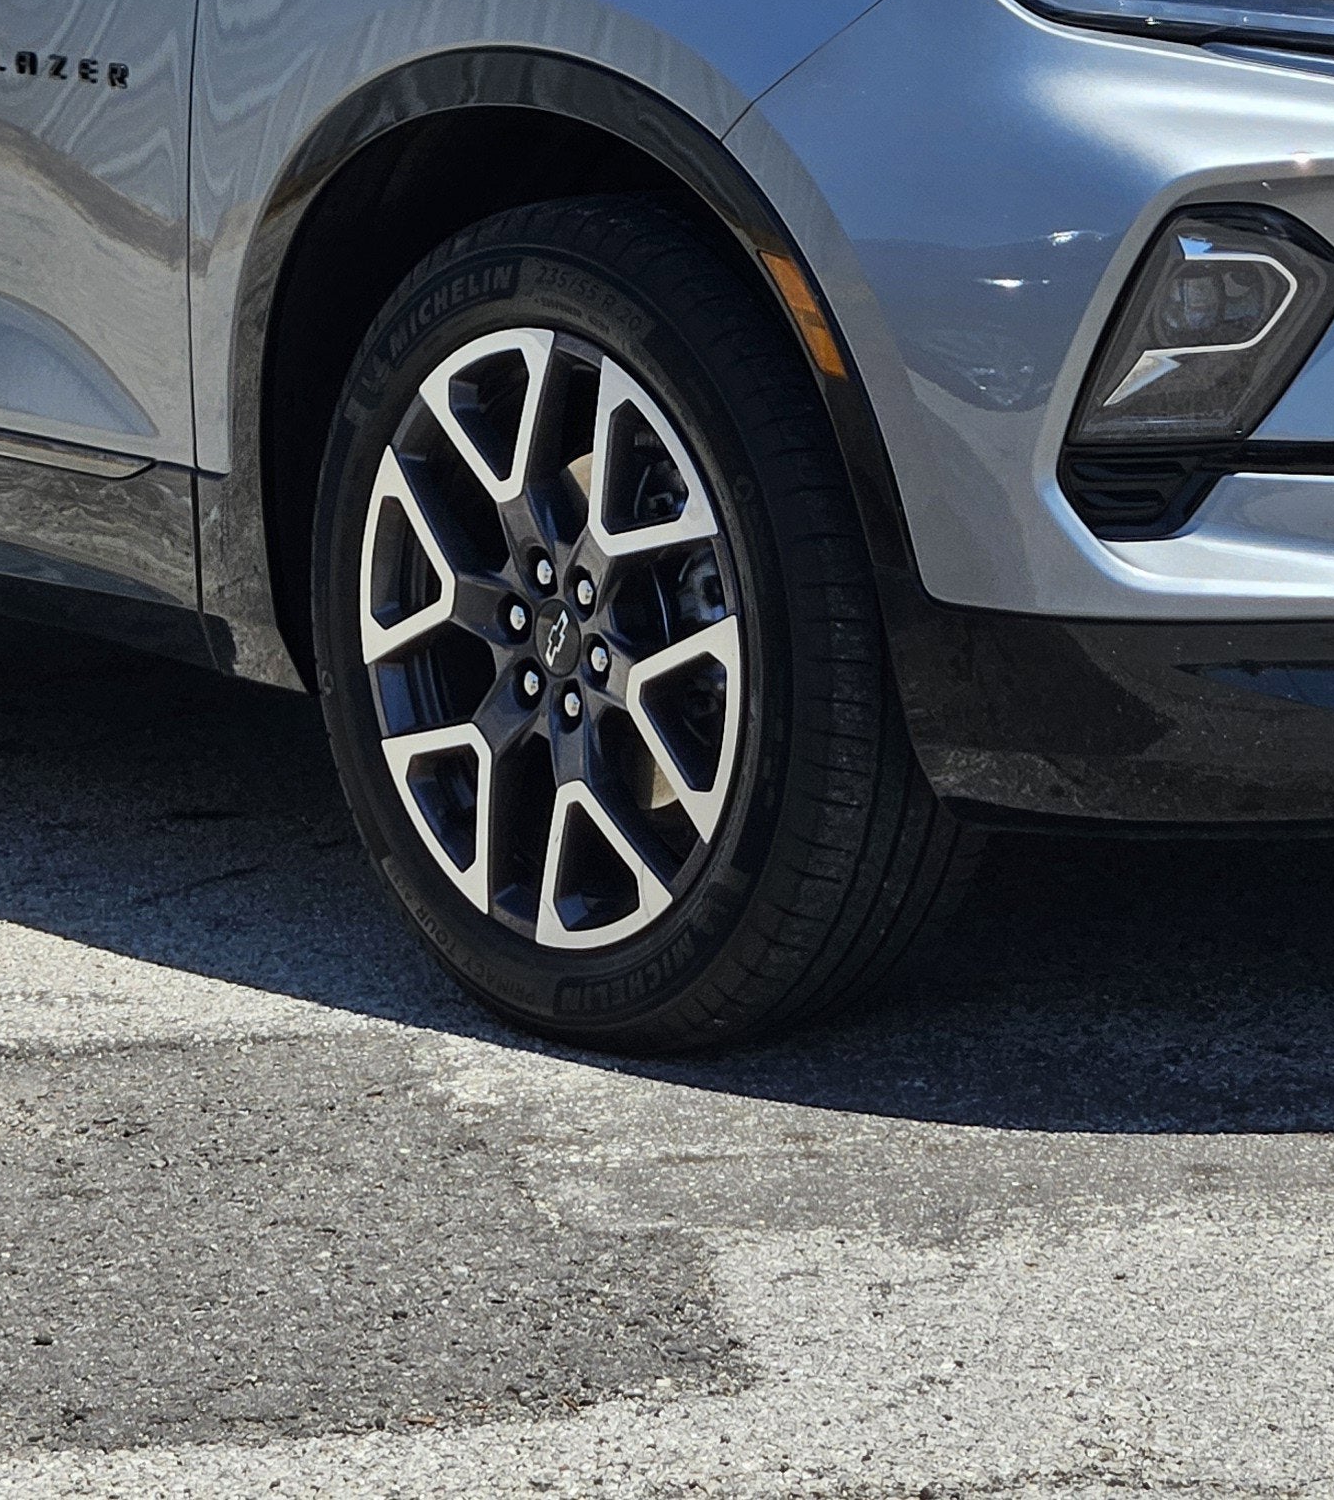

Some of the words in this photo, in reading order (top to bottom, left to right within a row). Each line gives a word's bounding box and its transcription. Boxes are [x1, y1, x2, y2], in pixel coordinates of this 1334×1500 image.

[389, 264, 513, 357] MICHELIN
[416, 903, 457, 957] TOUR
[560, 928, 696, 1011] MICHELIN
